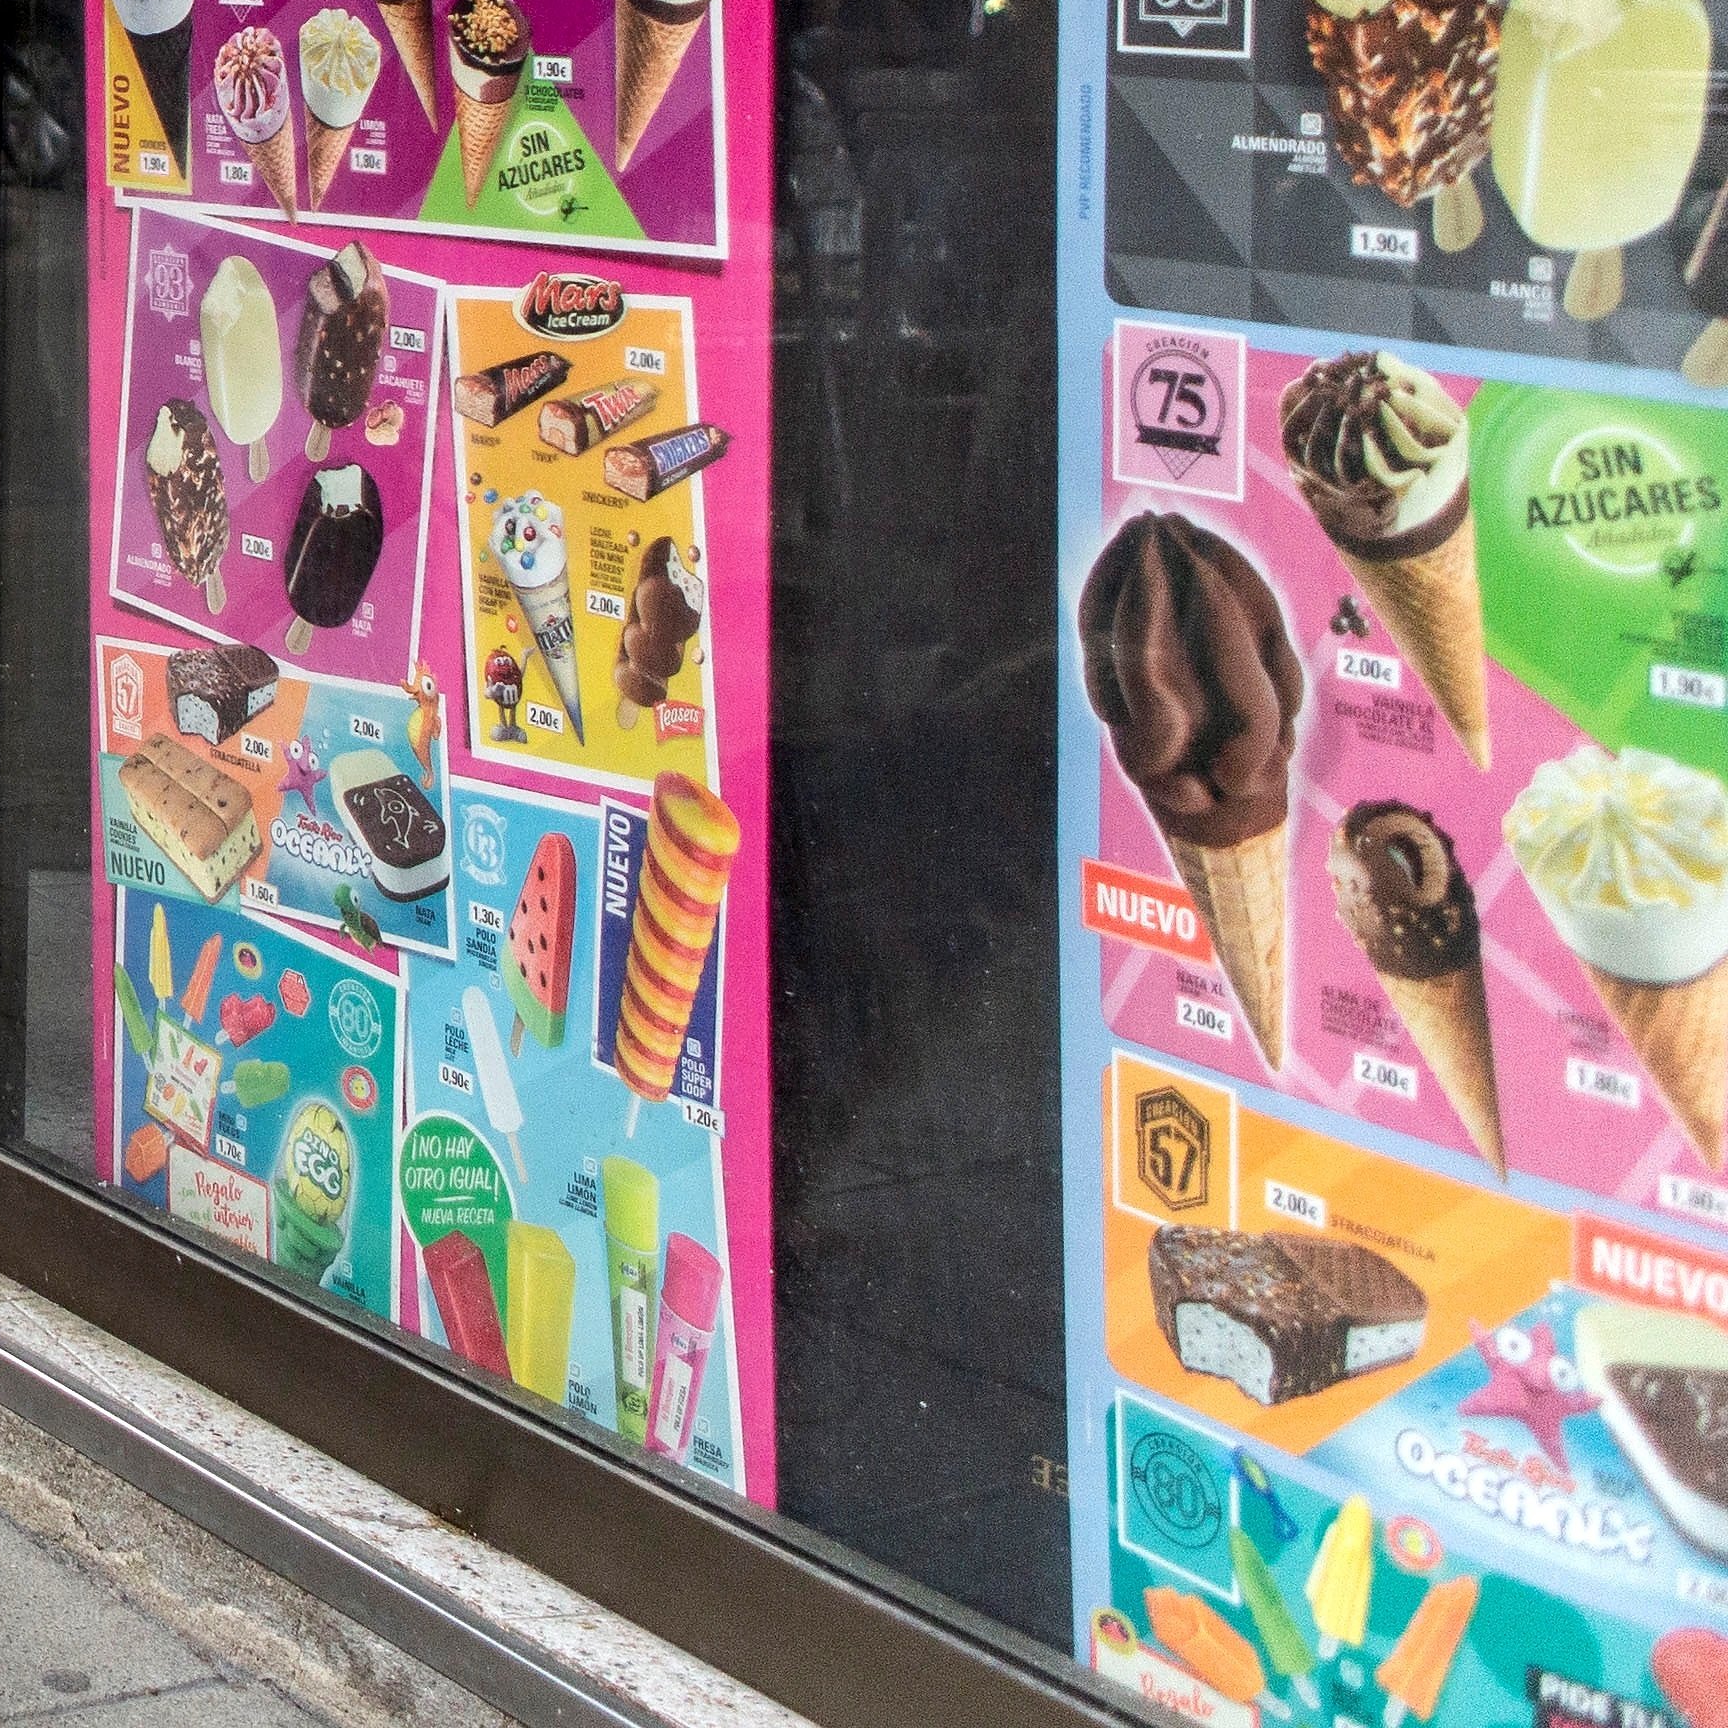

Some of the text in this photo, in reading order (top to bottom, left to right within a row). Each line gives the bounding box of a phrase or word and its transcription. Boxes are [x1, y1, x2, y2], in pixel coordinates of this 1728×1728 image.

[536, 61, 566, 79] 1,90€
[113, 74, 131, 175] NUEVO
[519, 130, 551, 158] SIN
[1231, 134, 1326, 157] ALMENDRADO
[154, 263, 185, 302] 93
[522, 271, 623, 318] Mars
[1490, 280, 1554, 302] BLANCO
[1148, 368, 1208, 430] 75
[650, 428, 712, 473] SNICKERS
[1577, 442, 1644, 482] SIN
[353, 719, 381, 740] 2,00€
[529, 707, 560, 730] 2,00€
[656, 702, 700, 731] Teasers
[244, 738, 270, 760] 2,00€
[109, 828, 137, 845] COOKIES
[111, 851, 166, 886] NUEVO
[604, 811, 632, 920] NUEVO
[473, 905, 500, 929] 1,30€
[1096, 882, 1198, 941] NUEVO
[475, 927, 497, 943] POLO
[1182, 1002, 1227, 1034] 2,00€
[444, 1023, 466, 1041] POLO
[444, 1033, 469, 1054] LECHE
[681, 1056, 706, 1075] POLO
[440, 1069, 470, 1091] 0,90€
[681, 1068, 712, 1090] SUPER
[681, 1081, 707, 1100] LOOP
[685, 1102, 720, 1132] 1,20€
[443, 1135, 474, 1161] HAY
[1149, 1123, 1199, 1193] 57
[195, 1171, 244, 1206] Regalo
[404, 1165, 445, 1191] OTRO
[572, 1172, 597, 1191] LIMA
[420, 1205, 495, 1226] NUEVA RECETA
[1272, 1187, 1320, 1221] 2,00€
[1591, 1236, 1728, 1318] NUEVO
[568, 1379, 591, 1398] POLO
[693, 1436, 723, 1460] FRESA
[1148, 1459, 1202, 1521] 80
